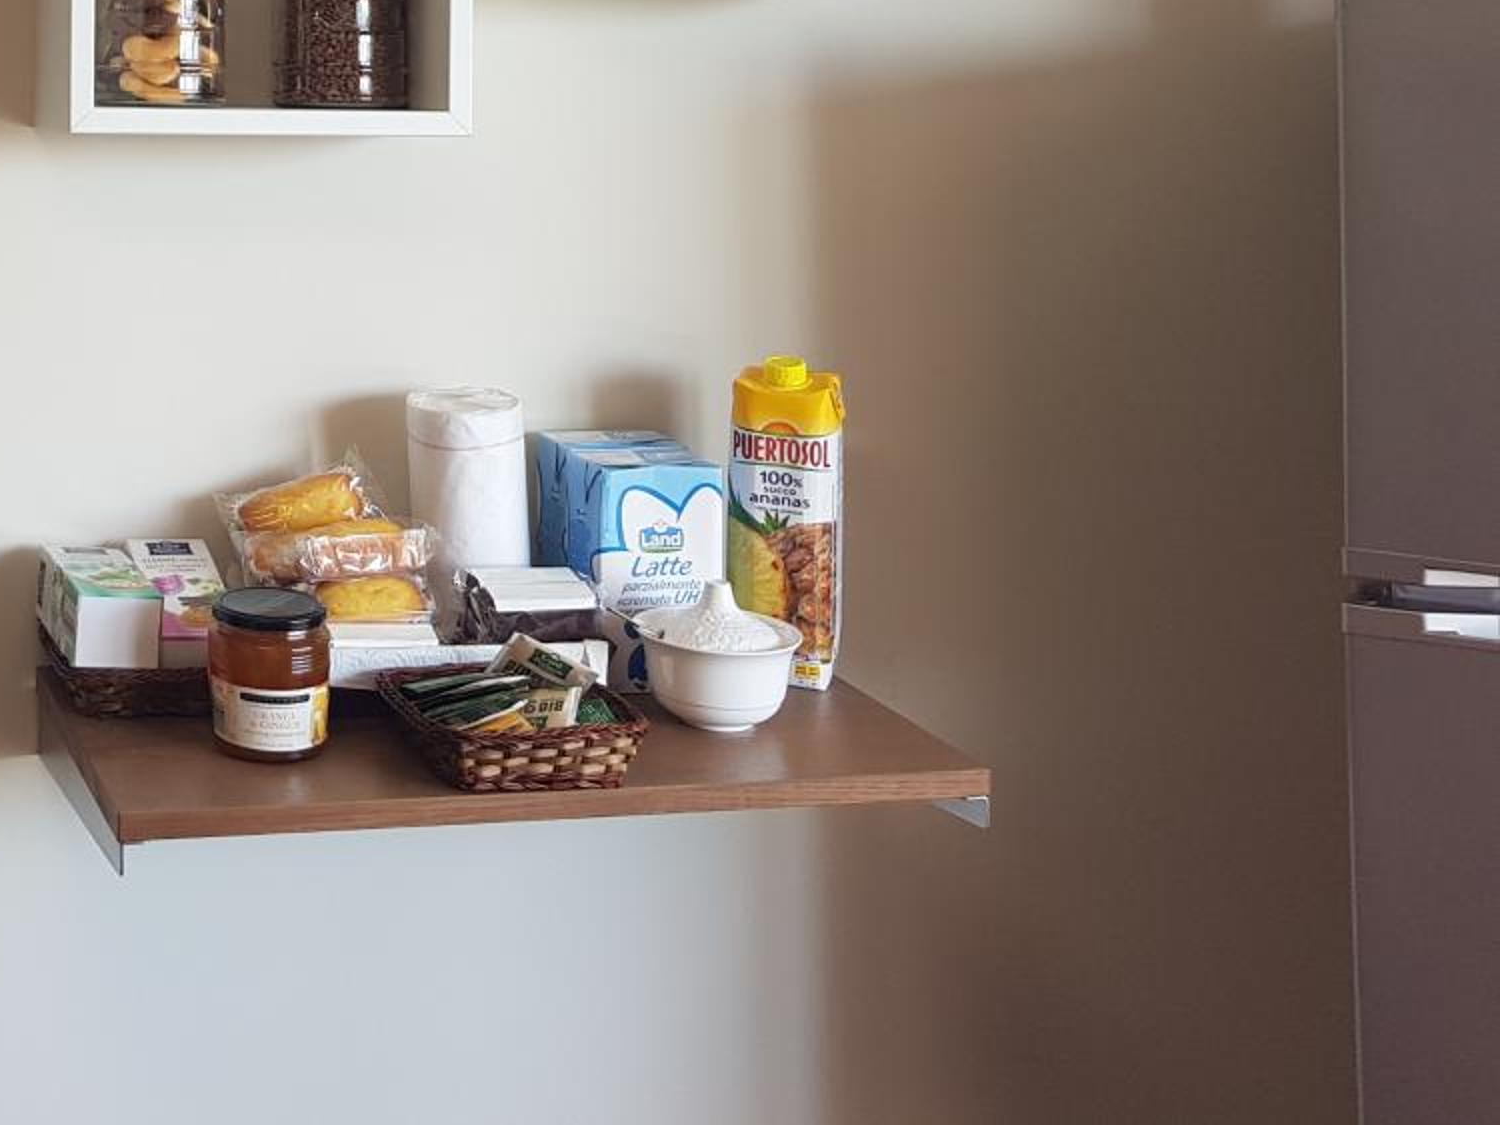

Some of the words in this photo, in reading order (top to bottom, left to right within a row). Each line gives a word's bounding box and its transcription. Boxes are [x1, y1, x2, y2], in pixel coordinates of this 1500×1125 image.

[733, 430, 831, 468] PUERTOSOL
[759, 470, 804, 488] 100%
[763, 485, 797, 496] succo
[749, 493, 811, 508] ananas
[642, 528, 682, 548] Land
[631, 556, 693, 577] Latte
[674, 590, 701, 604] UH
